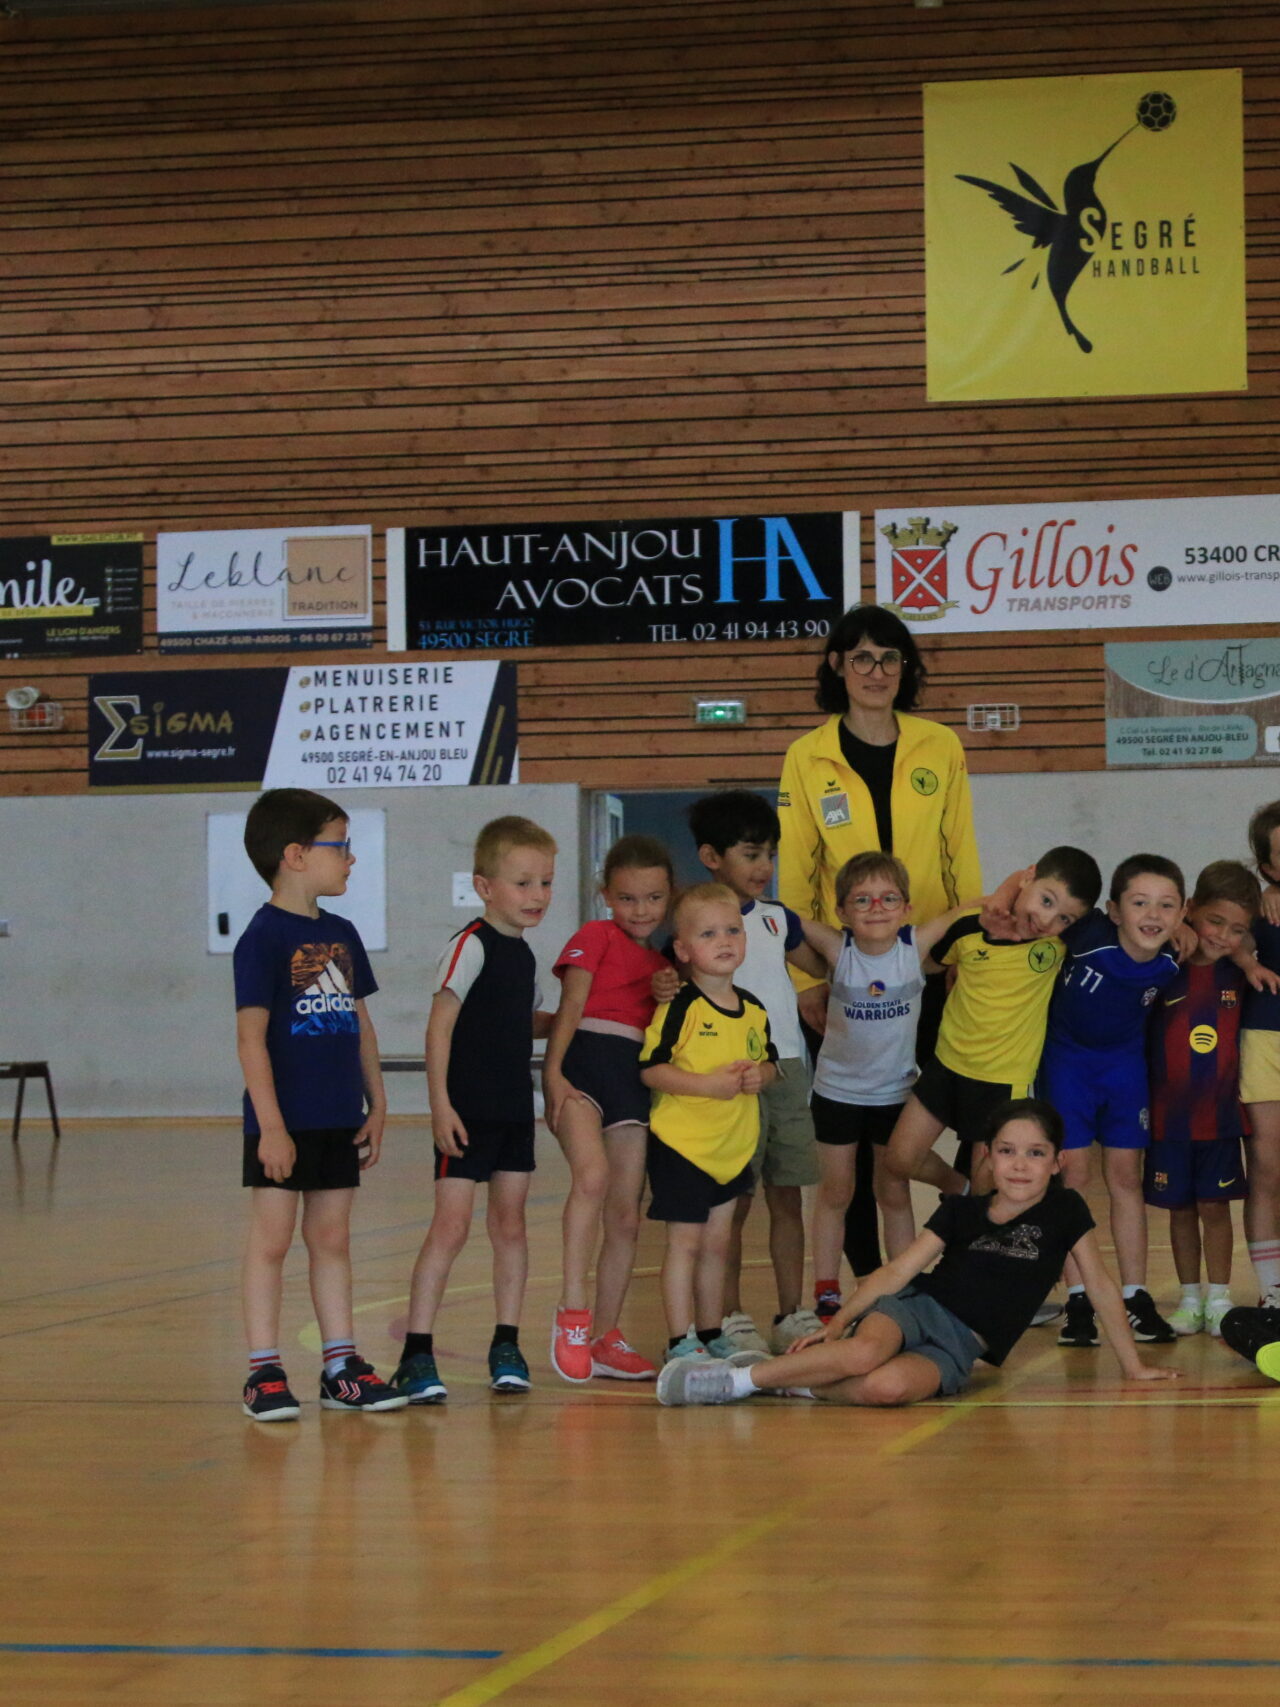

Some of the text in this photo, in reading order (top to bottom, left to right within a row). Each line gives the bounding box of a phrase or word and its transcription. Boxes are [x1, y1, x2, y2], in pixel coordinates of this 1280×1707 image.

[1079, 207, 1196, 254] SEGRÉ
[1092, 256, 1199, 278] HANDBALL
[417, 527, 702, 570] HAUT-ANJOU
[1184, 546, 1247, 566] 53400
[712, 517, 832, 603] HA
[964, 519, 1139, 614] Gillois
[168, 550, 356, 592] Leblanc
[494, 573, 704, 611] AVOCATS
[291, 600, 359, 613] TRADITION
[1006, 594, 1132, 613] TRANSPORTS
[418, 632, 471, 649] 49500
[647, 619, 831, 643] TEL. 02 41 94 43 90
[313, 666, 454, 688] MENUISERIE
[1148, 655, 1179, 686] Le
[314, 694, 439, 715] PLATRERIE
[313, 720, 466, 742] AGENCEMENT
[1176, 733, 1189, 743] EN
[1190, 732, 1249, 743] ANJOU-BLEU
[301, 748, 469, 764] 49500 SEGRÉ-EN-ANJOU BLEU
[1159, 746, 1171, 757] 02
[1172, 746, 1184, 757] 41
[1184, 746, 1197, 756] 92
[327, 763, 442, 784] 02 41 94 74 20
[843, 1002, 911, 1021] WARRIORS
[852, 998, 902, 1009] GOLDEN STATE
